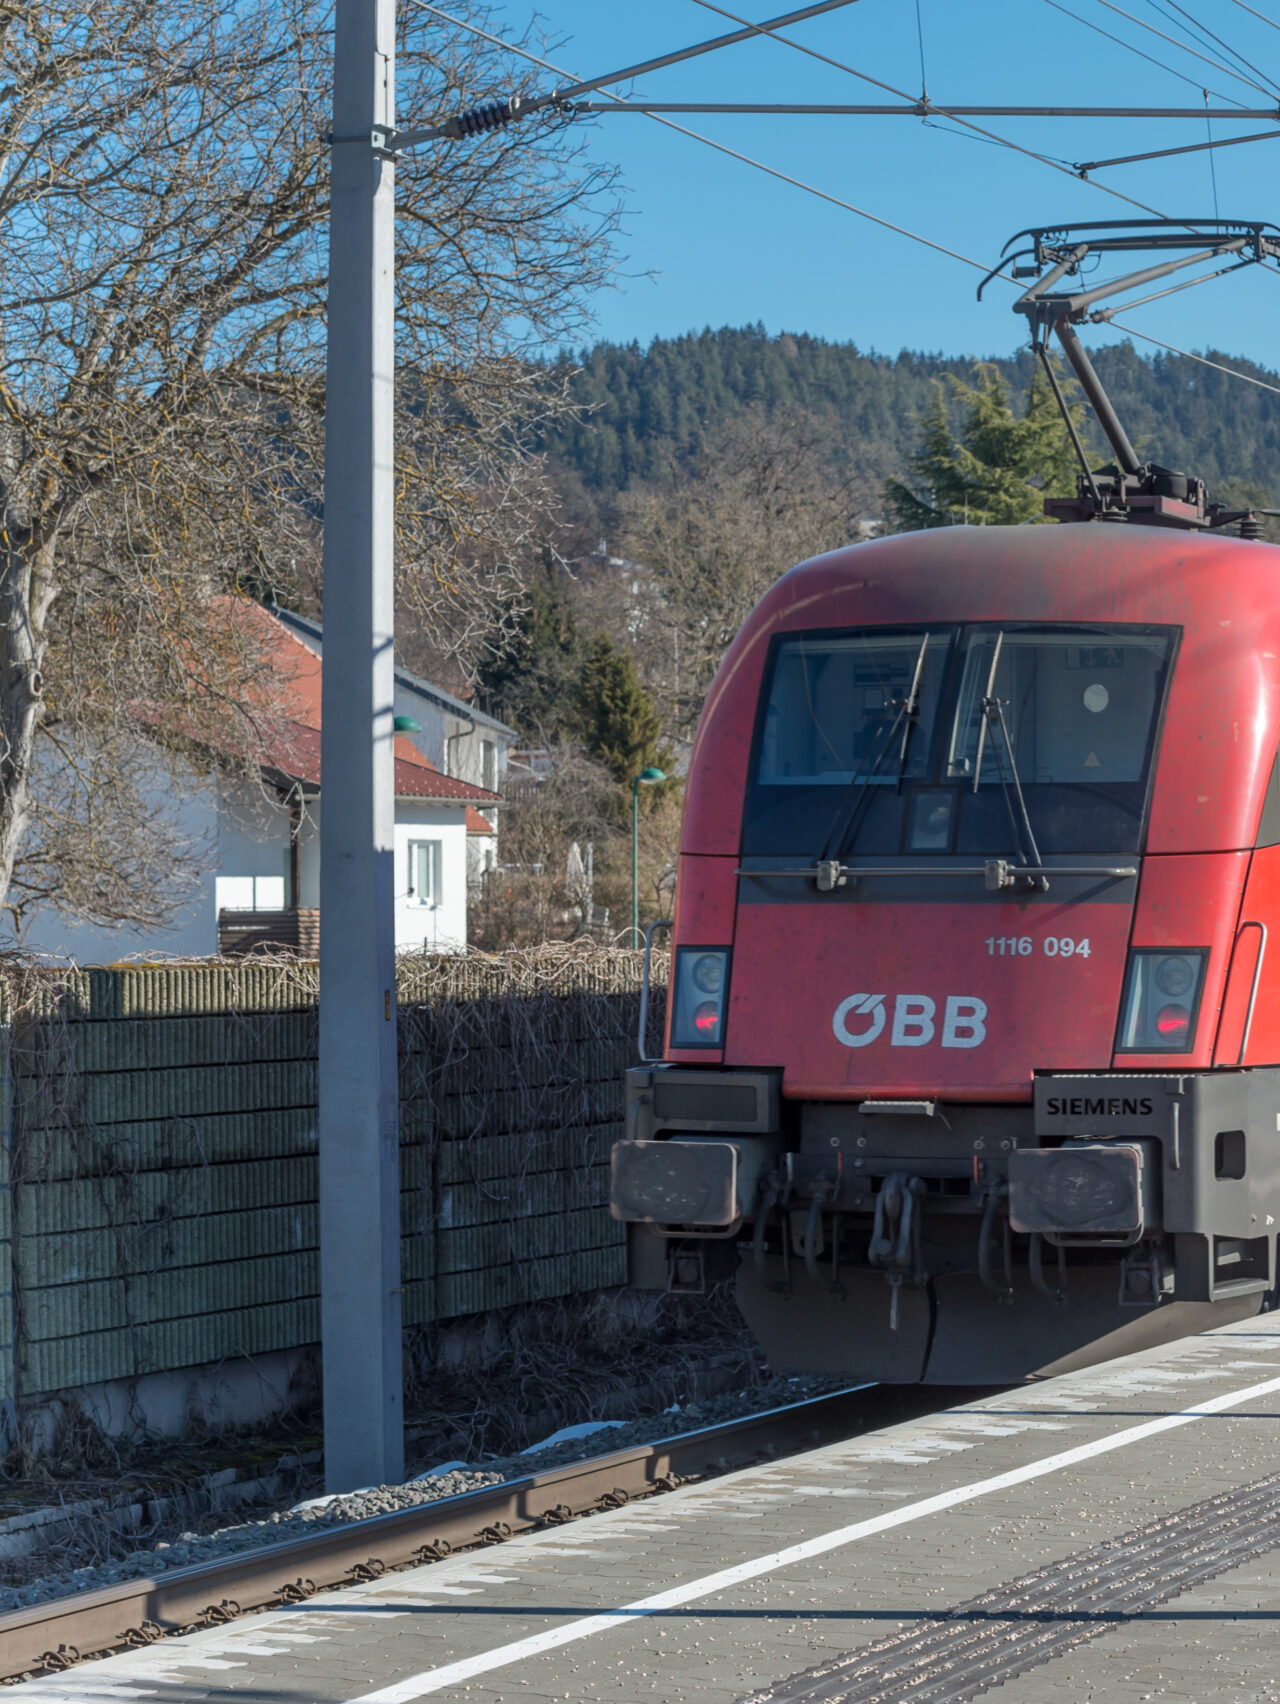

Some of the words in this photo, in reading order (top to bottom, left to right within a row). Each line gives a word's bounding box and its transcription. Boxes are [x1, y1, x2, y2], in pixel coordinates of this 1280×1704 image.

[985, 937, 1034, 956] 1116
[1043, 936, 1092, 959] 094
[832, 993, 988, 1049] ÖBB
[1046, 1098, 1154, 1116] SIEMENS
